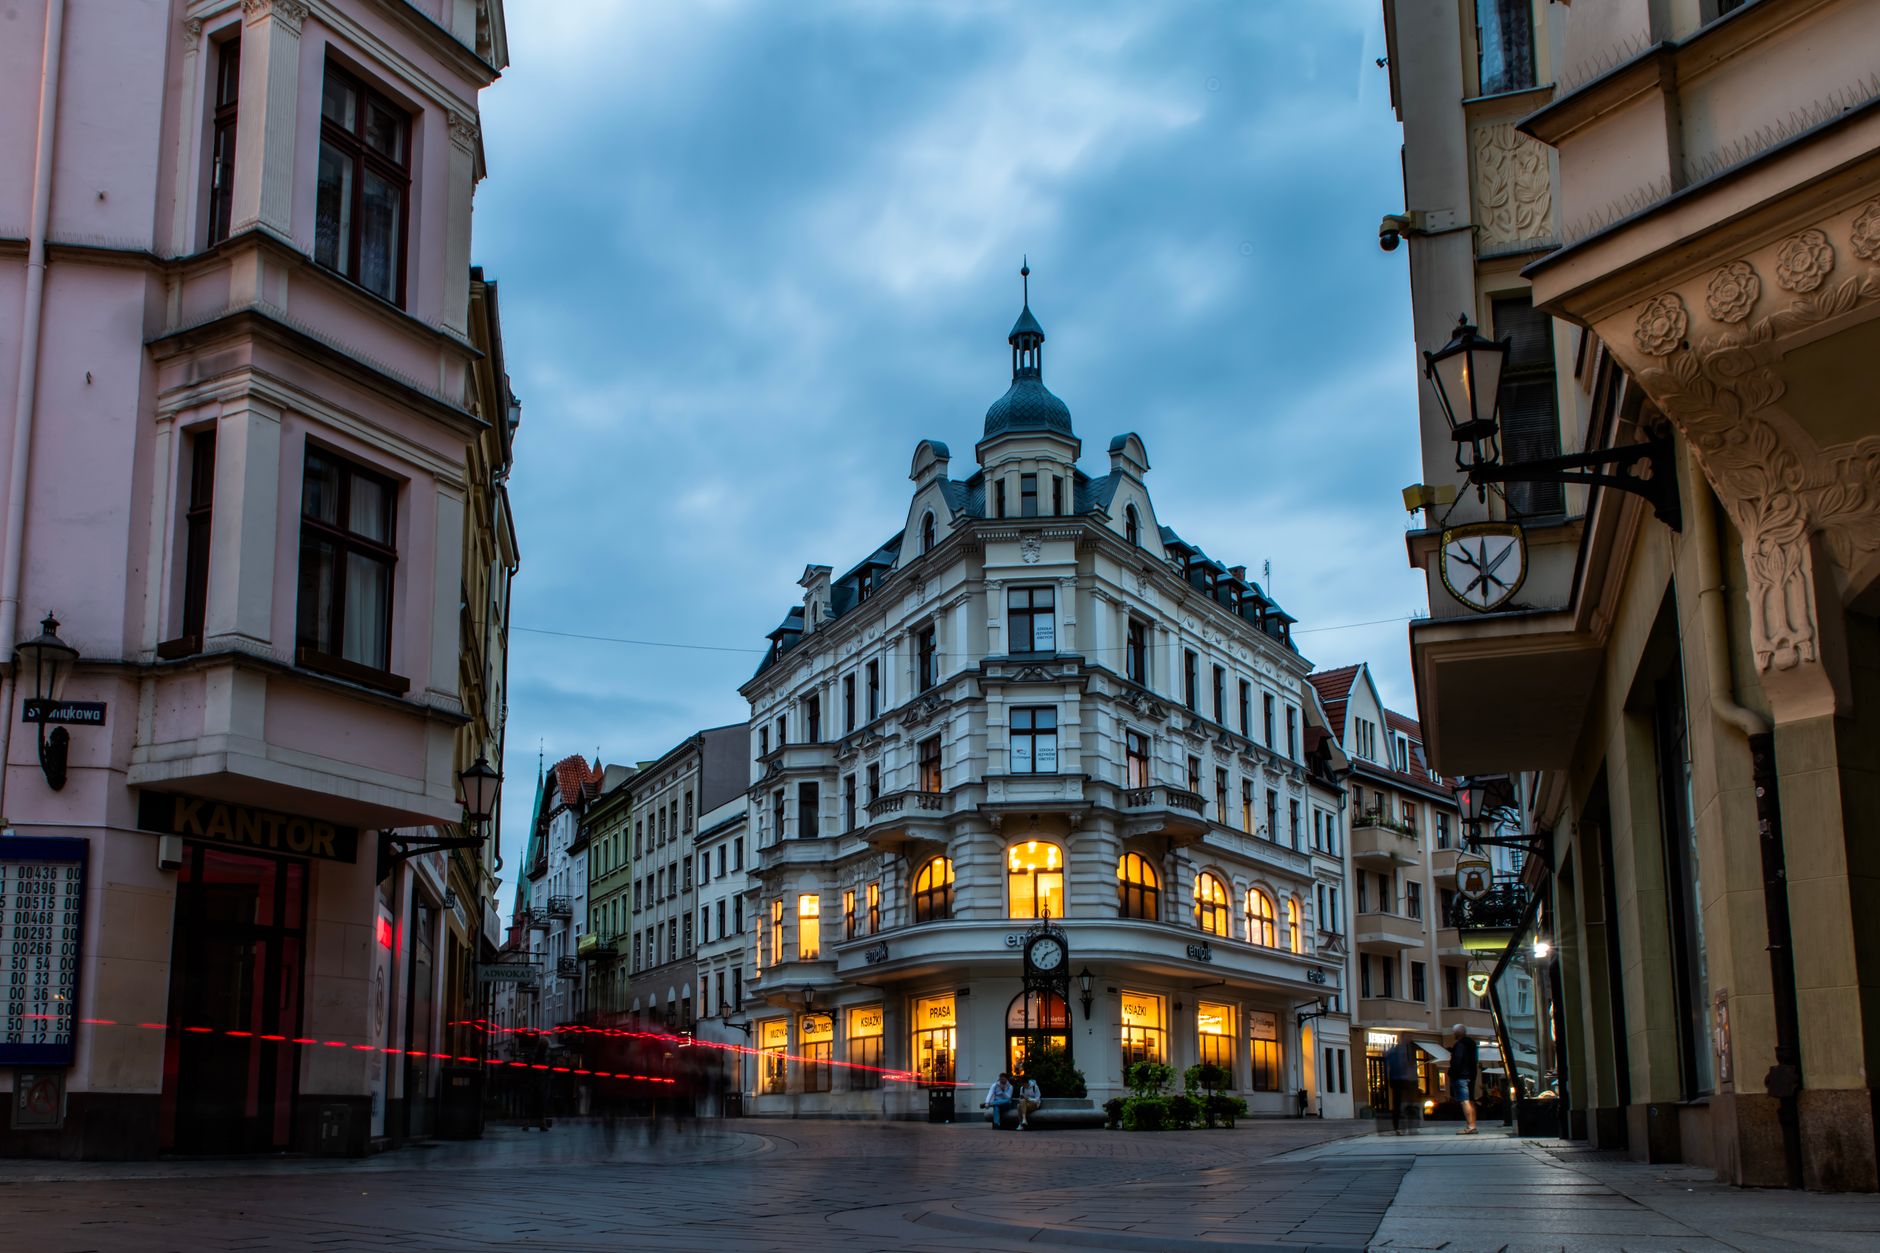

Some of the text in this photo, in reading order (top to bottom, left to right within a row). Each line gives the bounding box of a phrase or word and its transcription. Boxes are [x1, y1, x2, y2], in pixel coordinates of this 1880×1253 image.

[173, 795, 336, 857] KANTOR
[865, 943, 888, 965] empik
[12, 957, 26, 970] 50
[36, 957, 50, 970] 54
[11, 972, 25, 984] 00
[35, 973, 49, 985] 33
[483, 969, 532, 979] ADWOKAT
[10, 987, 24, 1000] 00
[34, 988, 48, 1000] 36
[929, 1005, 951, 1019] PRASA
[8, 1018, 22, 1030] 50
